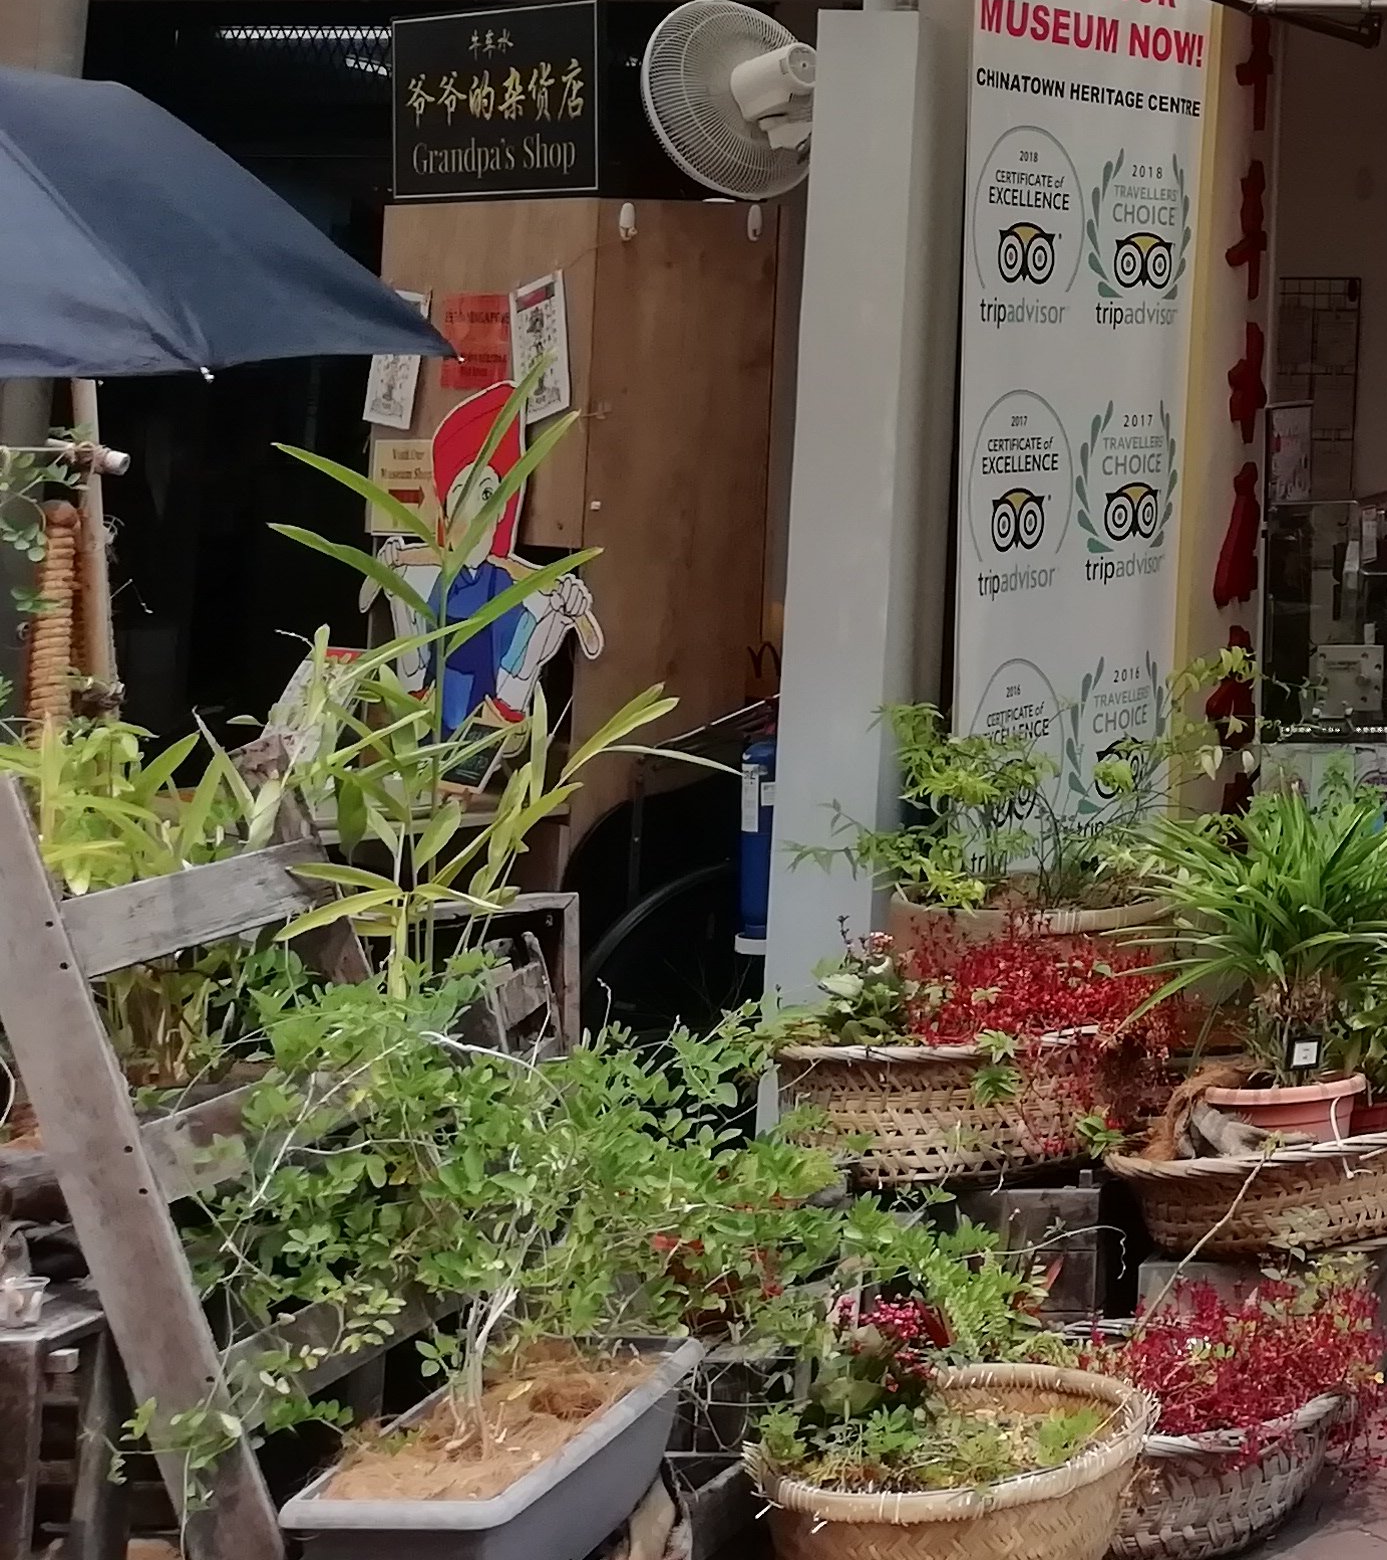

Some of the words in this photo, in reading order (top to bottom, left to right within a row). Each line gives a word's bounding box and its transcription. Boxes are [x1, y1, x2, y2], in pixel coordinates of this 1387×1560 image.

[1129, 23, 1204, 68] NOW!
[405, 58, 585, 129] 爷爷的杂货店
[976, 67, 1065, 98] CHINATOWN
[1070, 83, 1144, 109] HERITAGE
[1148, 94, 1201, 117] CENTRE
[413, 137, 516, 179] Grandpa's
[523, 133, 576, 175] Shop
[1019, 150, 1038, 163] 2018
[995, 169, 1053, 188] CERTIFICATE
[1054, 176, 1064, 188] of
[1132, 165, 1162, 179] 2018
[988, 186, 1070, 211] EXCELLENCE
[1112, 203, 1176, 226] CHOICE
[980, 297, 1066, 328] tripadvisor
[1096, 301, 1177, 329] tripadvisor
[1011, 416, 1028, 427] 2017
[1123, 414, 1154, 428] 2017
[987, 438, 1043, 452] CERTIFICATE
[1043, 436, 1053, 450] of
[982, 453, 1059, 475] EXCELLENCE
[1102, 453, 1162, 476] CHOICE
[1085, 552, 1162, 585] tripadvisor
[978, 564, 1056, 601] tripadvisor
[1113, 667, 1140, 683] 2016
[1006, 685, 1021, 699] 2016
[986, 706, 1033, 728] CERTIFICATE
[1035, 701, 1045, 715] of
[1092, 703, 1148, 734] CHOICE
